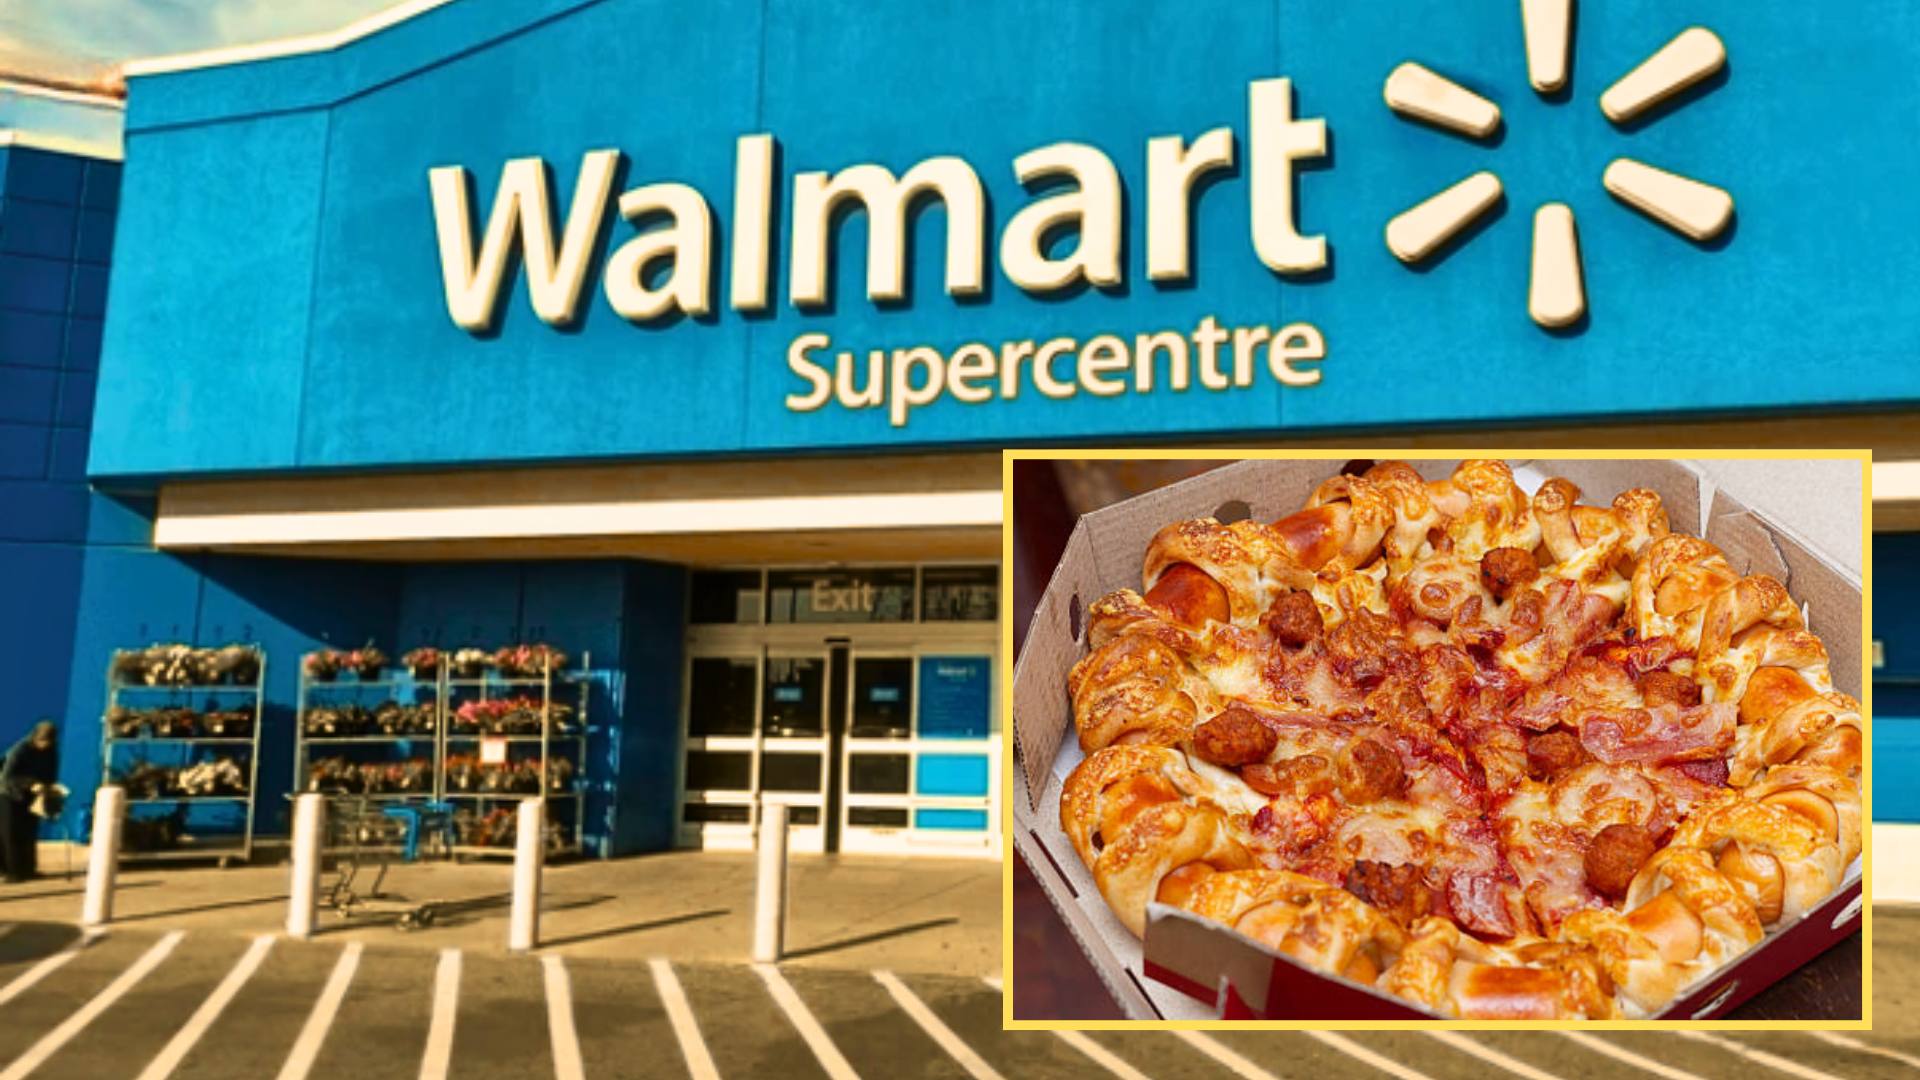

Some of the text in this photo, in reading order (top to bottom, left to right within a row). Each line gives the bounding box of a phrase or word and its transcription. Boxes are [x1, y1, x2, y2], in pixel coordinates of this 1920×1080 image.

[428, 77, 1328, 331] Walmart
[785, 316, 1325, 426] Supercentre
[812, 579, 875, 612] Exit
